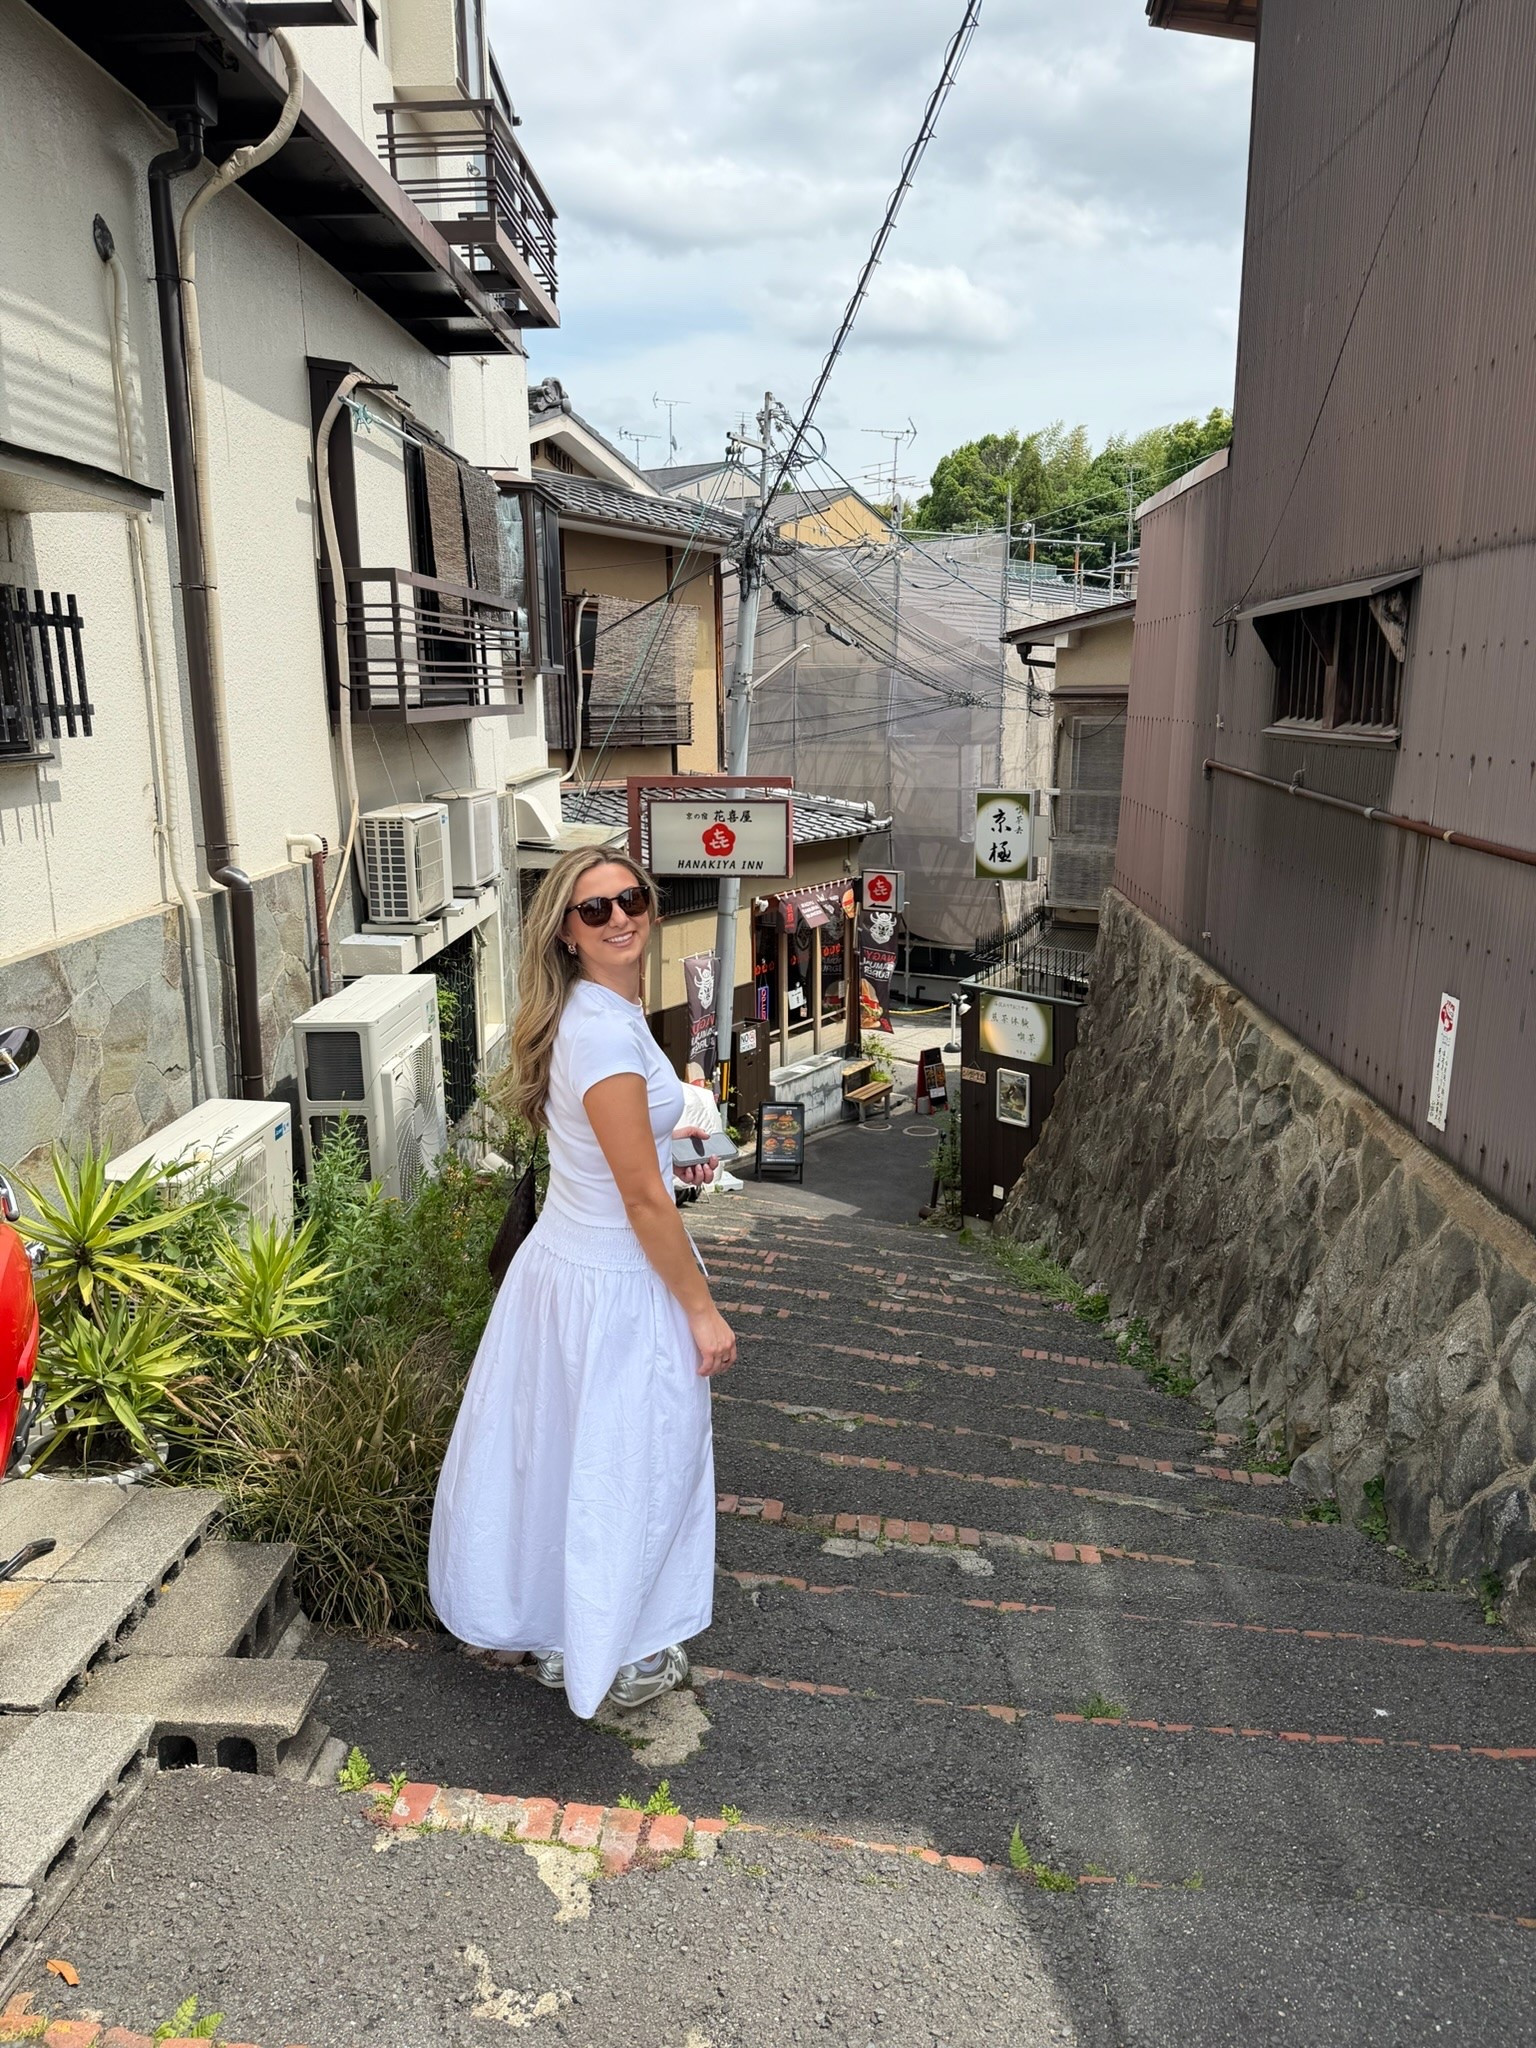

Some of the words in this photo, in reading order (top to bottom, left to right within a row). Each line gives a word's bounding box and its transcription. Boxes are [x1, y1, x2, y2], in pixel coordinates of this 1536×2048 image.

[713, 809, 753, 823] 花喜屋
[988, 808, 1012, 863] 京極
[677, 859, 736, 870] HANAKIYA
[741, 860, 764, 870] INN
